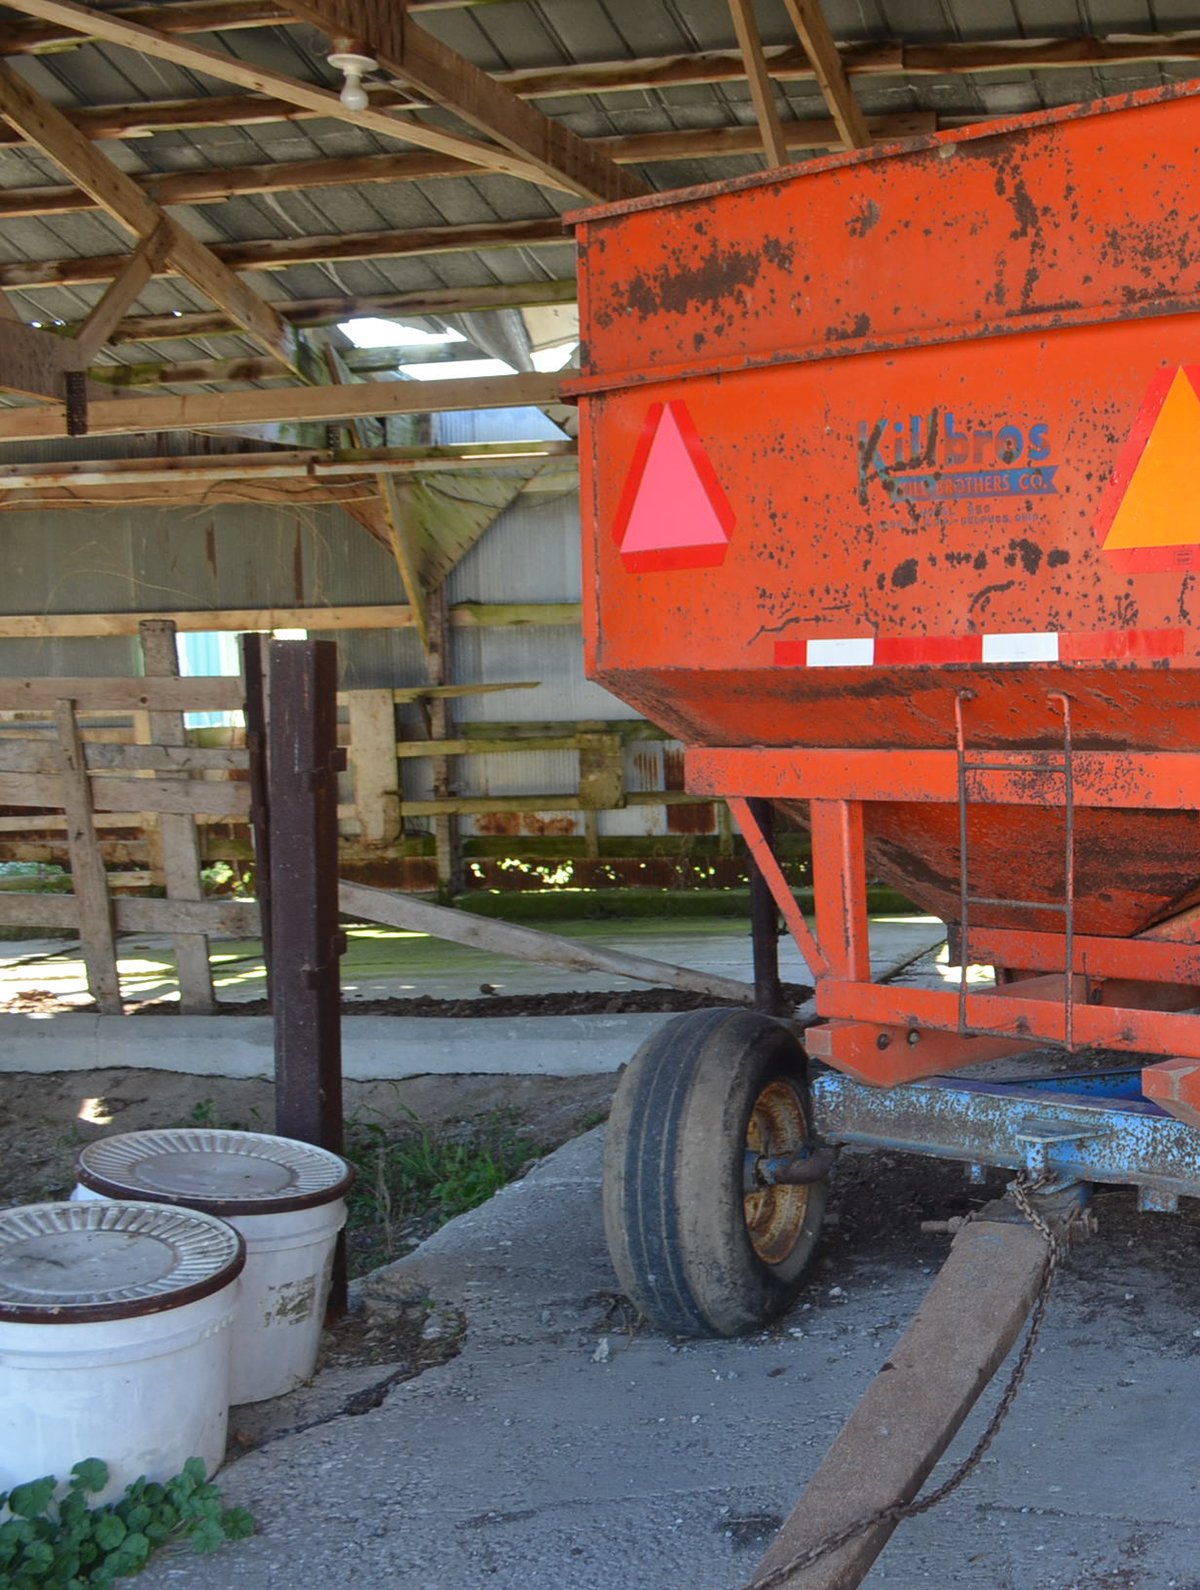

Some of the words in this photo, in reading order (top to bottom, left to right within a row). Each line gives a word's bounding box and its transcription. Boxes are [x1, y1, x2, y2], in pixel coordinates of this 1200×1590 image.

[858, 408, 1051, 505] Killbros
[936, 474, 1010, 494] BROTHERS
[1019, 472, 1048, 491] CO.
